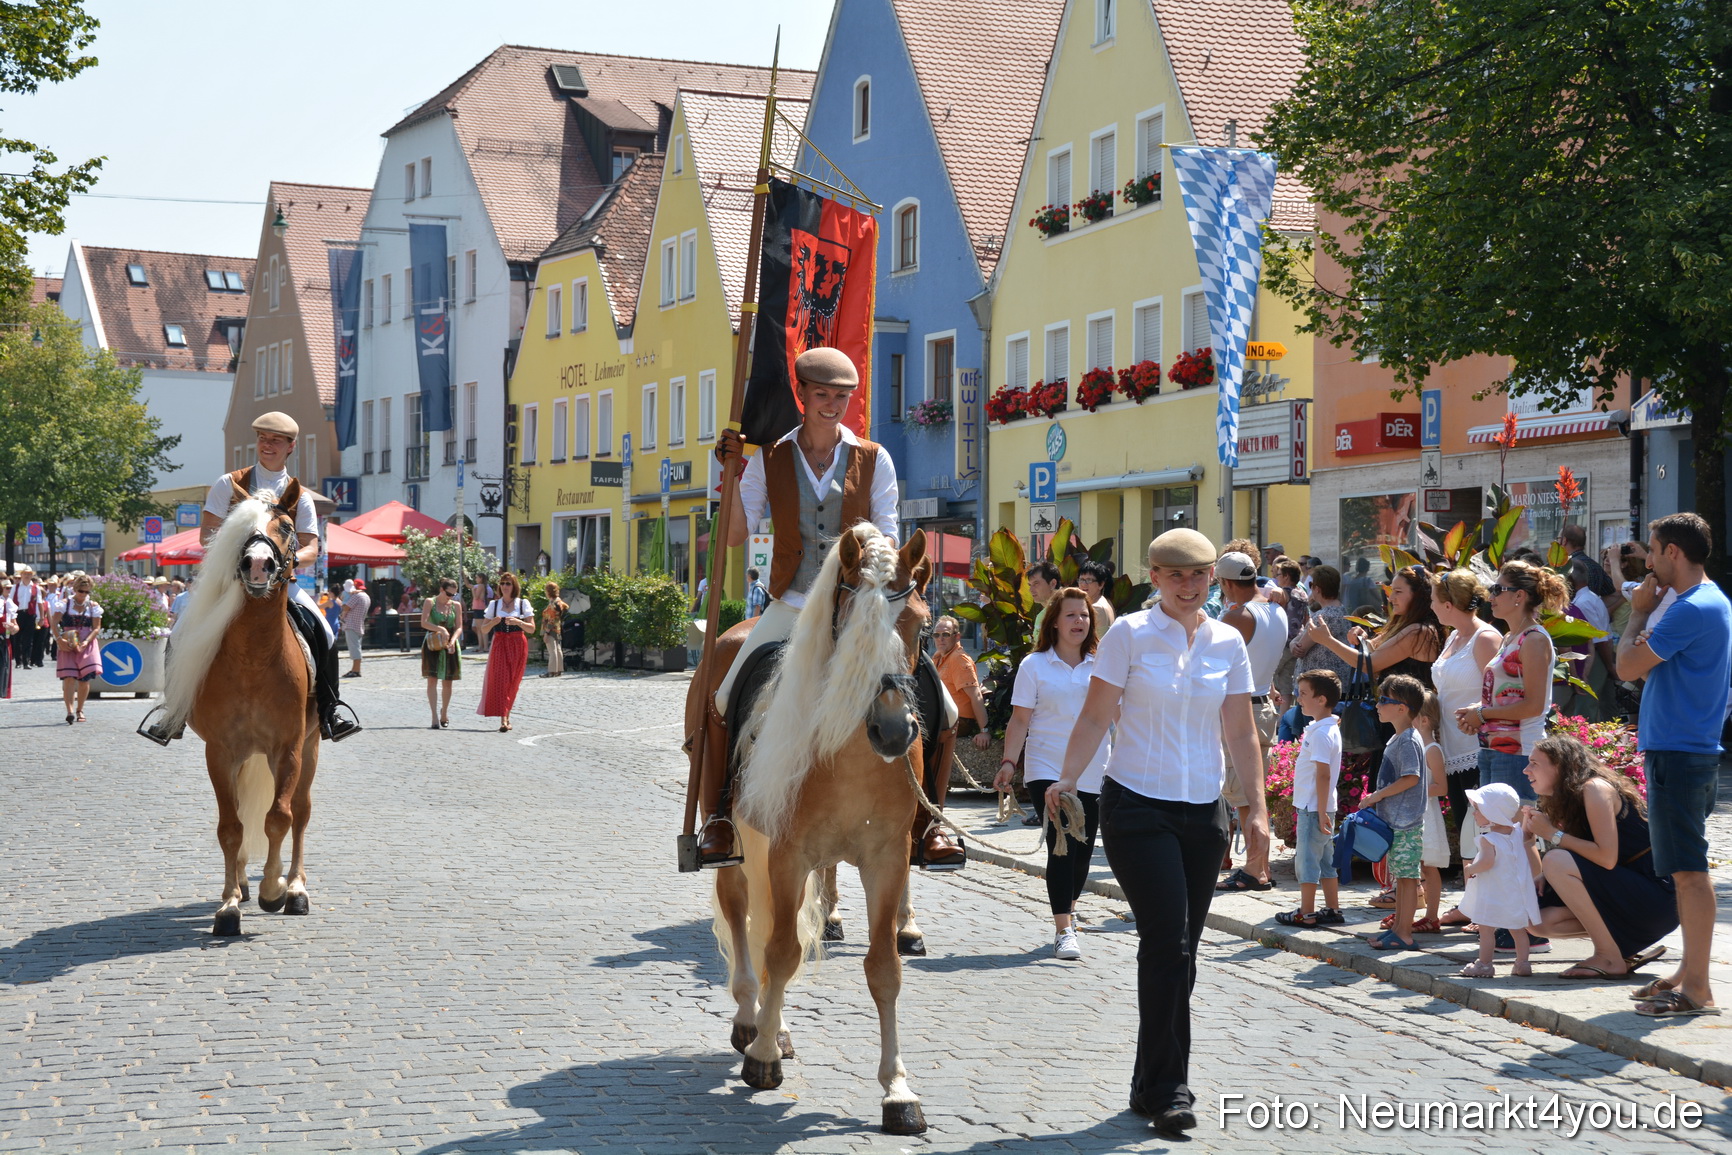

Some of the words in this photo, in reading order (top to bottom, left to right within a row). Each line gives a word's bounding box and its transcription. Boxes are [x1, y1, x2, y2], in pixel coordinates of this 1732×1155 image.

[560, 362, 588, 390] HOTEL
[594, 359, 626, 382] Lehmeier
[960, 369, 979, 387] CAFÉ
[1425, 397, 1437, 439] P
[961, 389, 977, 470] WITTL
[1294, 403, 1305, 477] KINO
[1386, 422, 1414, 437] DER
[624, 438, 629, 463] P
[1261, 434, 1279, 451] KINO
[663, 463, 668, 489] P
[1655, 464, 1666, 480] 16
[1035, 467, 1051, 499] P
[556, 488, 595, 506] Restaurant
[1511, 493, 1536, 507] MARIO
[146, 534, 161, 542] TAXI
